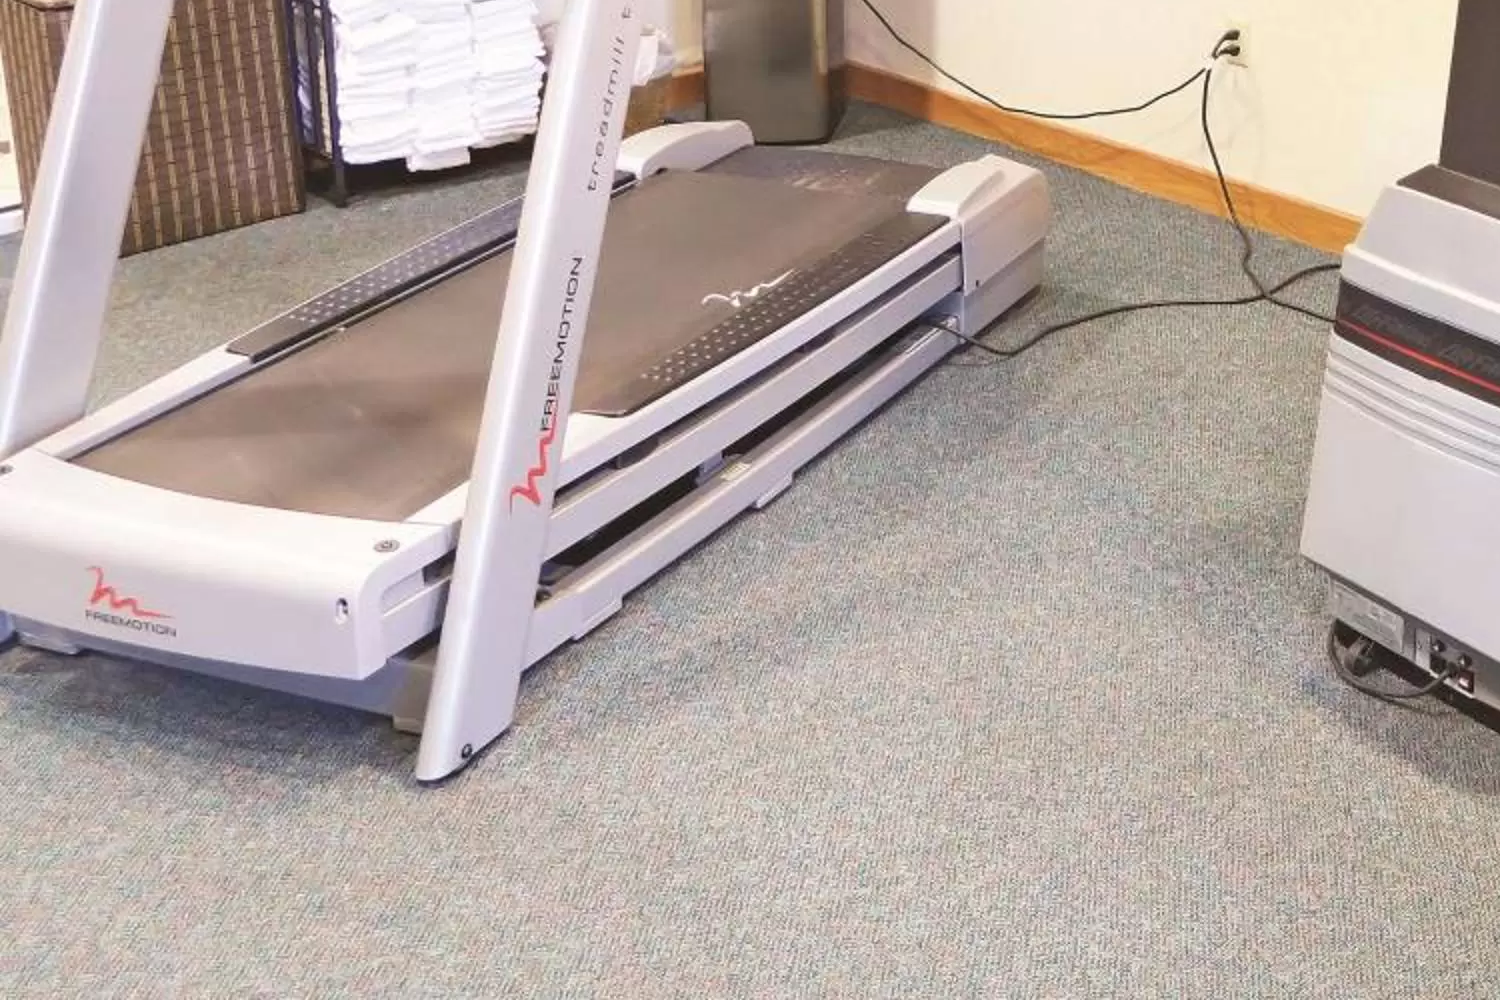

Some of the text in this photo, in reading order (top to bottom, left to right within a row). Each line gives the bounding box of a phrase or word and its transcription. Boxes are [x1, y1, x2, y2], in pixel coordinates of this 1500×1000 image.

[588, 36, 625, 192] treadmill
[540, 256, 583, 432] FREEMOTION
[85, 609, 176, 637] FREEMOTION
